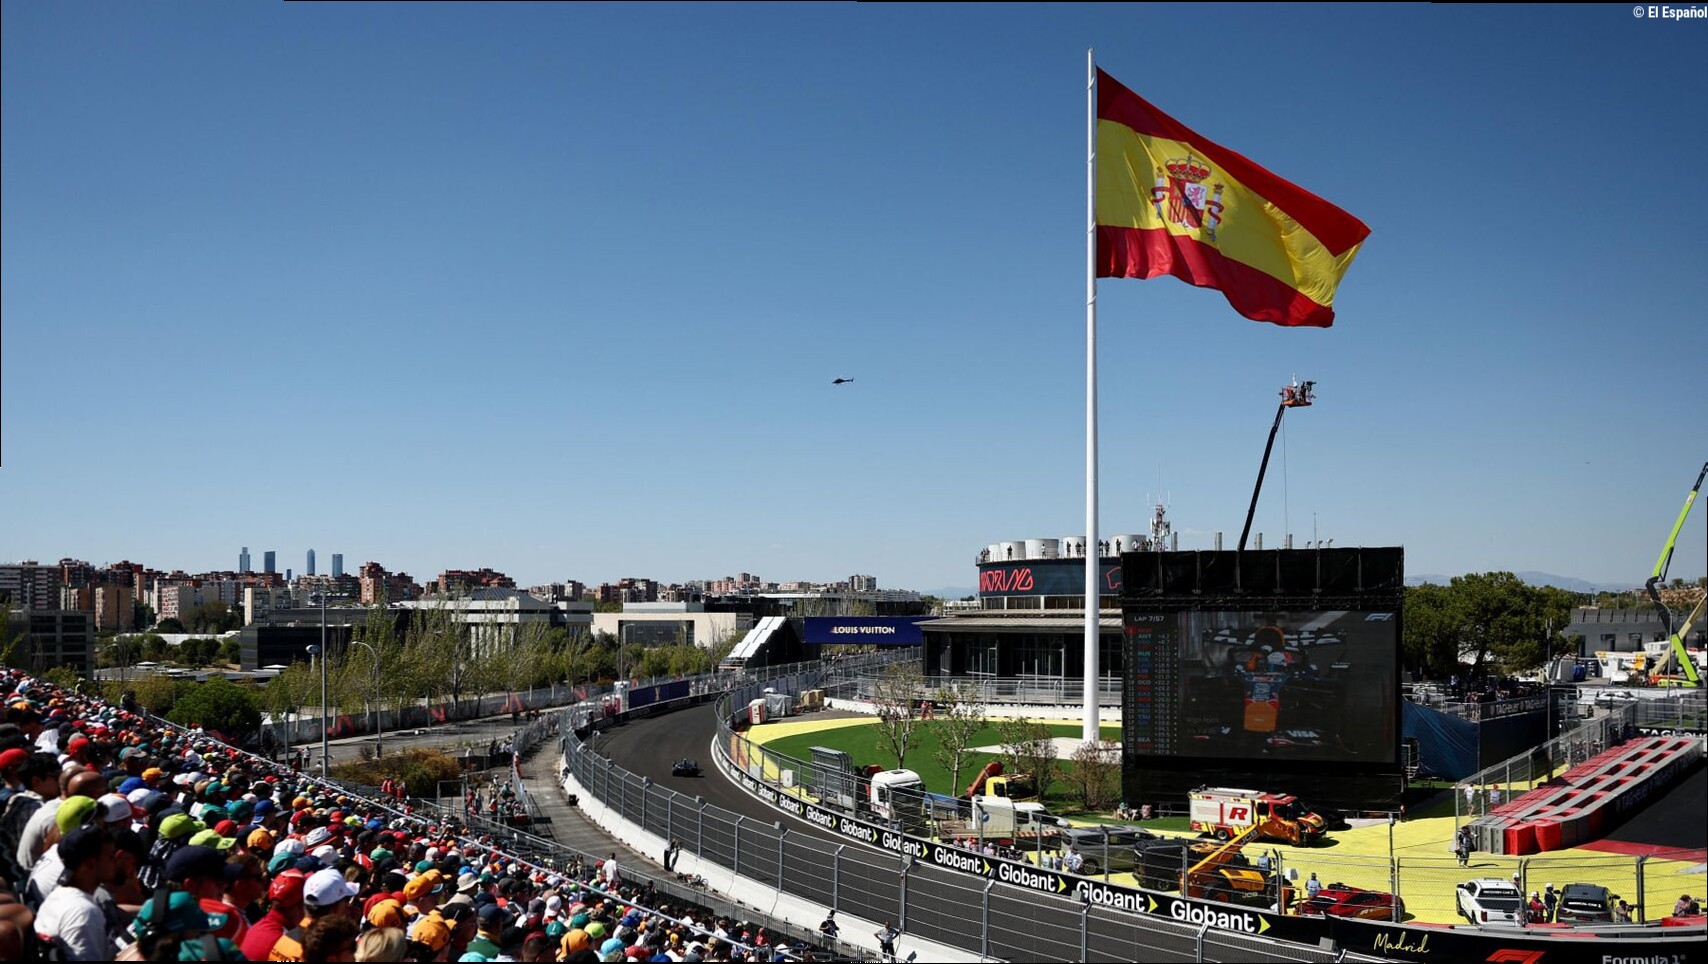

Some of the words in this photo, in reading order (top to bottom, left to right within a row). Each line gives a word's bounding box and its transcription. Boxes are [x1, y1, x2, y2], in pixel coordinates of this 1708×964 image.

[834, 626, 858, 634] LOUIS
[860, 626, 895, 634] VUITTON
[1287, 729, 1320, 738] VISA
[780, 794, 799, 814] Globant
[1229, 807, 1248, 820] R
[806, 806, 832, 827] Globant
[840, 818, 872, 841] Globant
[1241, 829, 1258, 845] JCB
[934, 847, 981, 873] Globant
[999, 863, 1056, 892] Globant
[1076, 881, 1146, 912] Globant
[1171, 901, 1255, 933] Globant
[1373, 931, 1430, 953] Madrid
[1602, 955, 1669, 964] Formula
